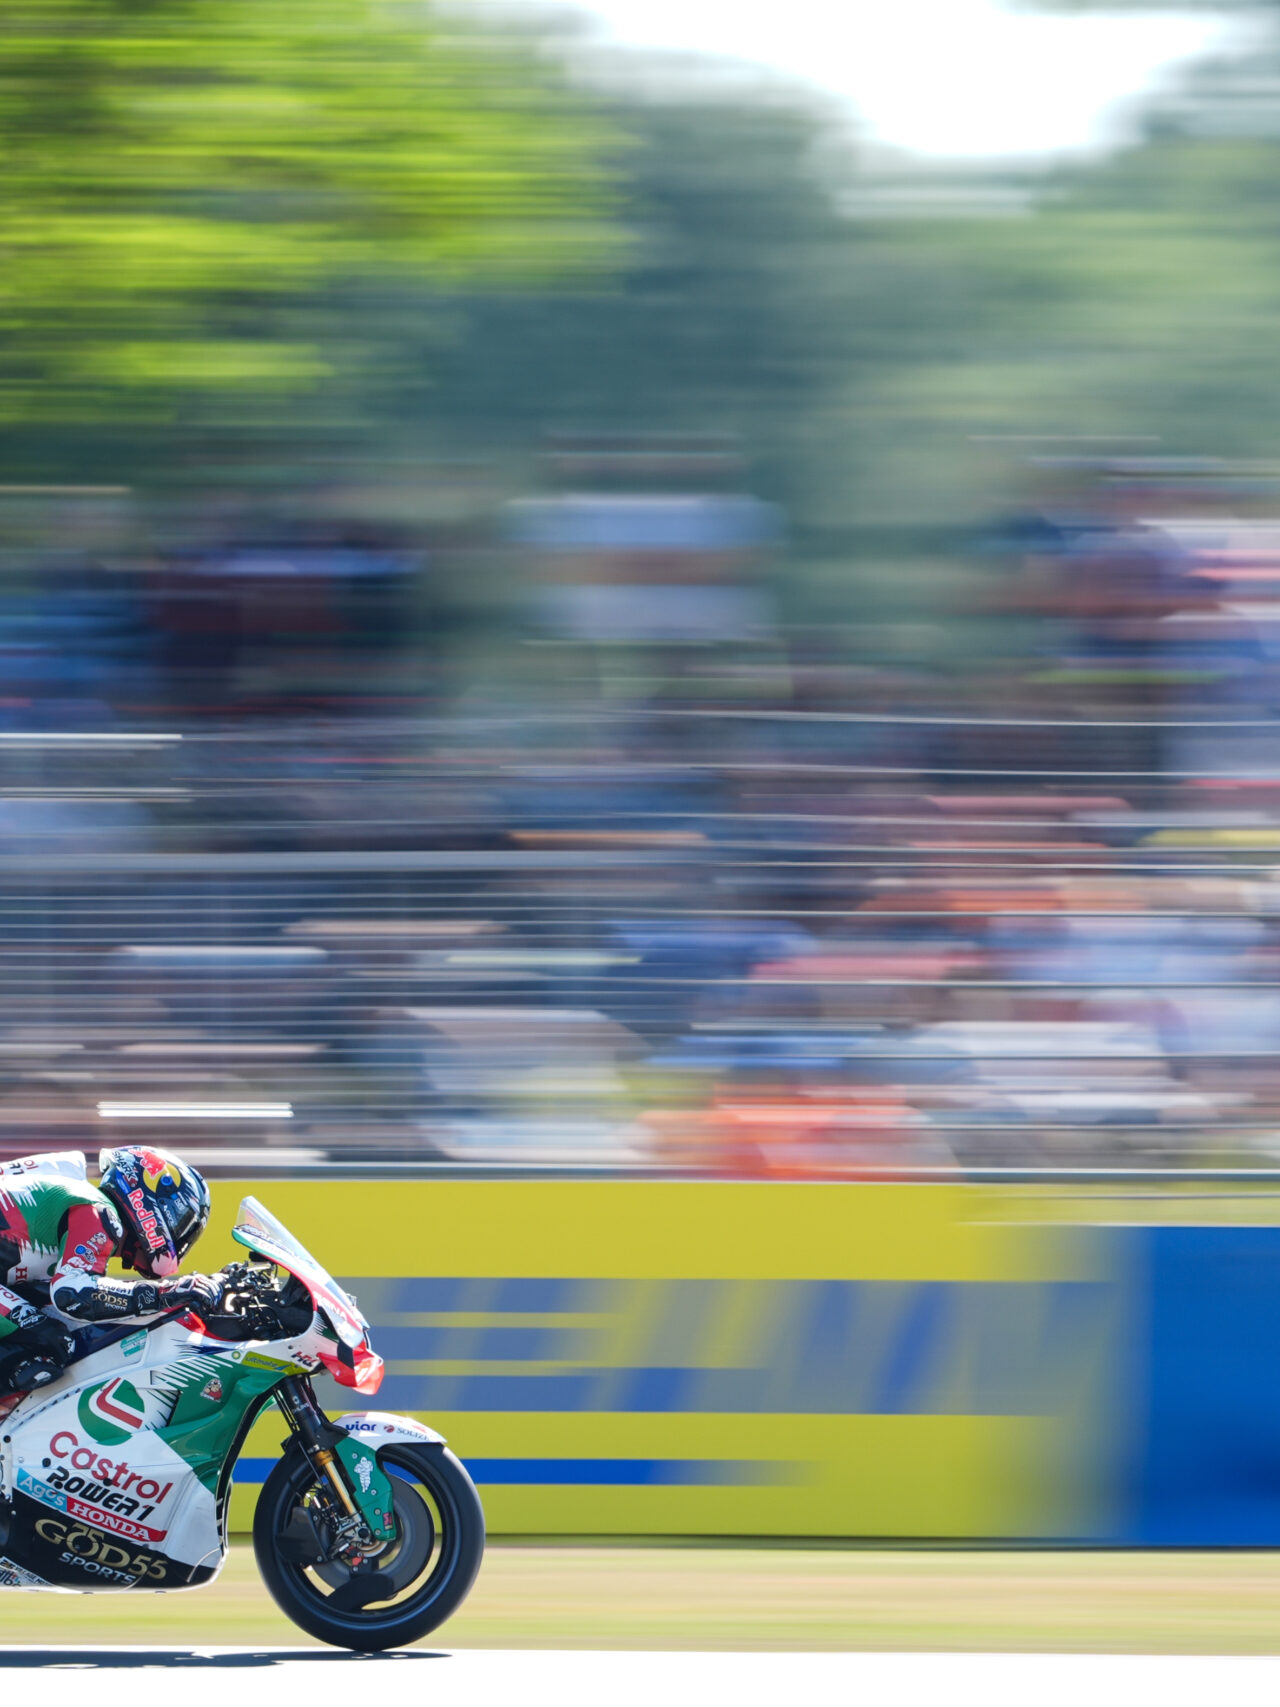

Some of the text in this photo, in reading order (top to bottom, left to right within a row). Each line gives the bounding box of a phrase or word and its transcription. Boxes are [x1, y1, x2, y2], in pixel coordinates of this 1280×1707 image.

[345, 1421, 377, 1431] viar
[49, 1431, 174, 1504] Castrol
[46, 1466, 155, 1521] POWER1
[70, 1502, 151, 1541] HONDA
[58, 1551, 139, 1585] SPORTS
